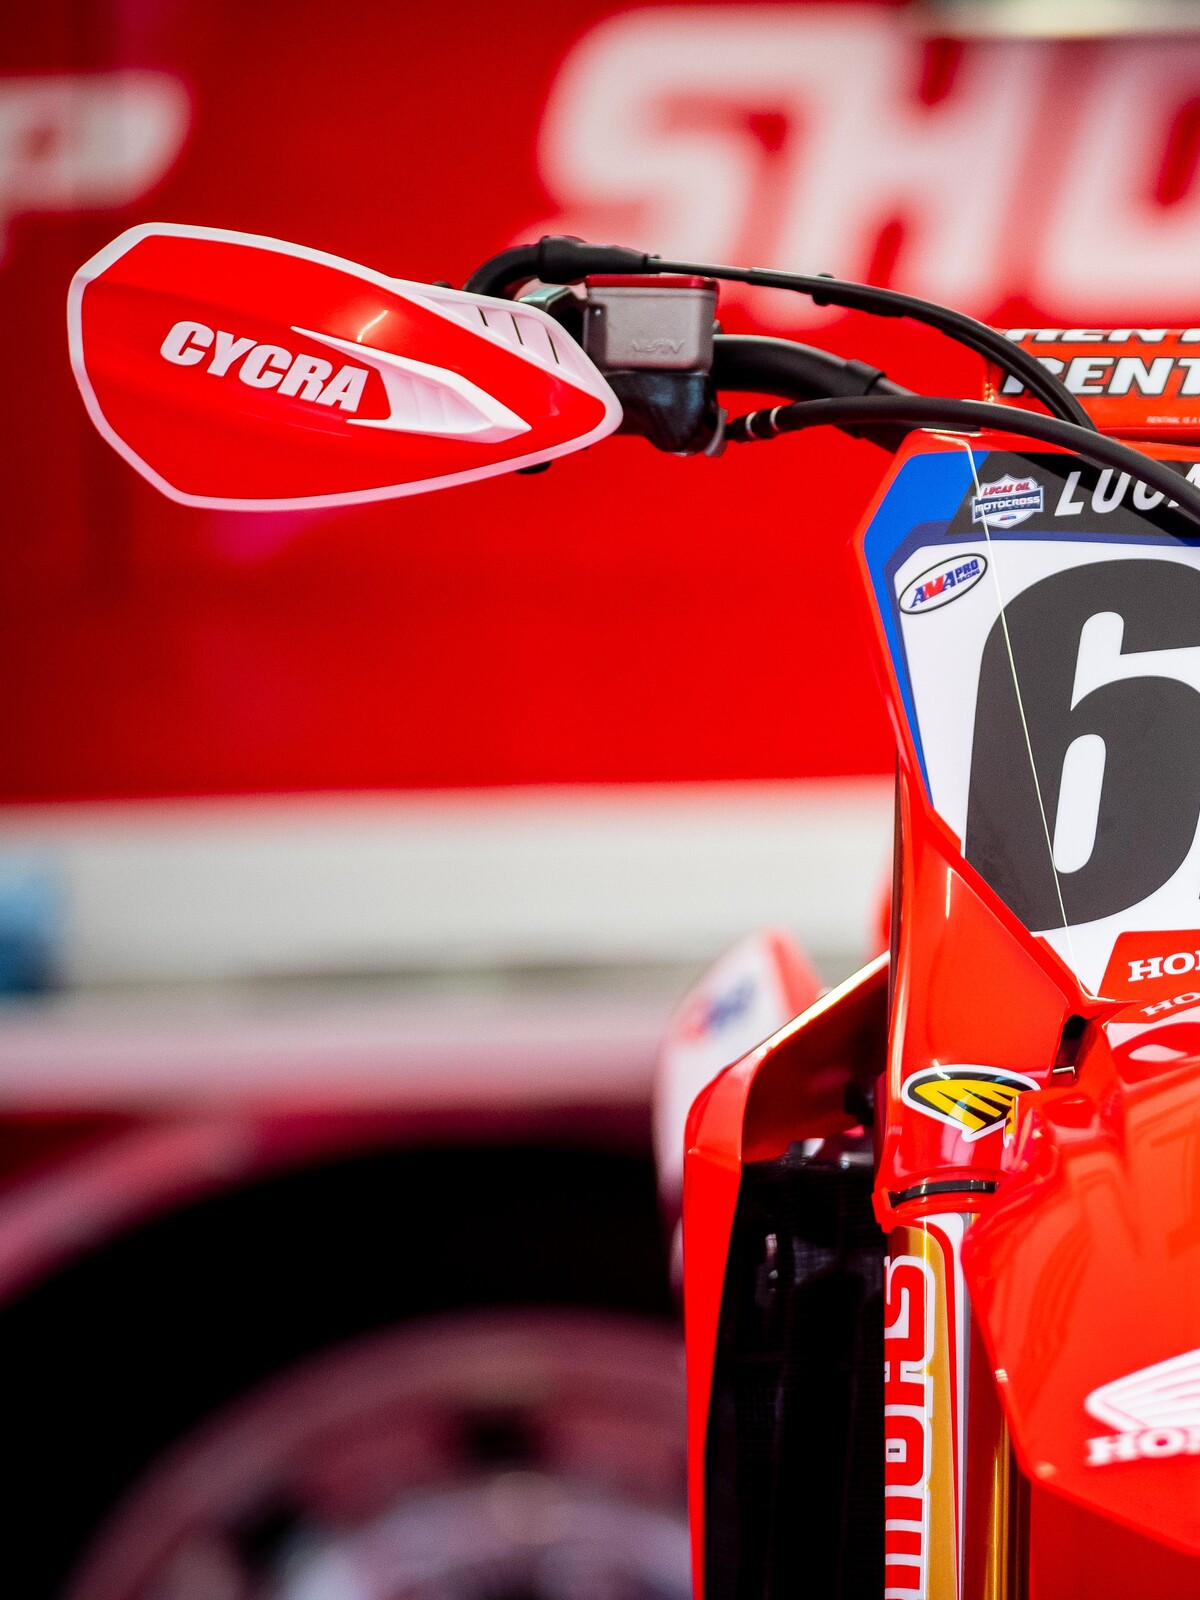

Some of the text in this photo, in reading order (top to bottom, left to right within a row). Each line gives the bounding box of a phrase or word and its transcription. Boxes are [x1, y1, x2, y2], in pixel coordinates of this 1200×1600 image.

[160, 320, 369, 413] CYCRA
[983, 482, 1030, 496] LUCAS OIL
[975, 496, 1041, 513] MOTOCROSS
[909, 559, 979, 609] AMA PRO
[956, 568, 981, 584] RACING
